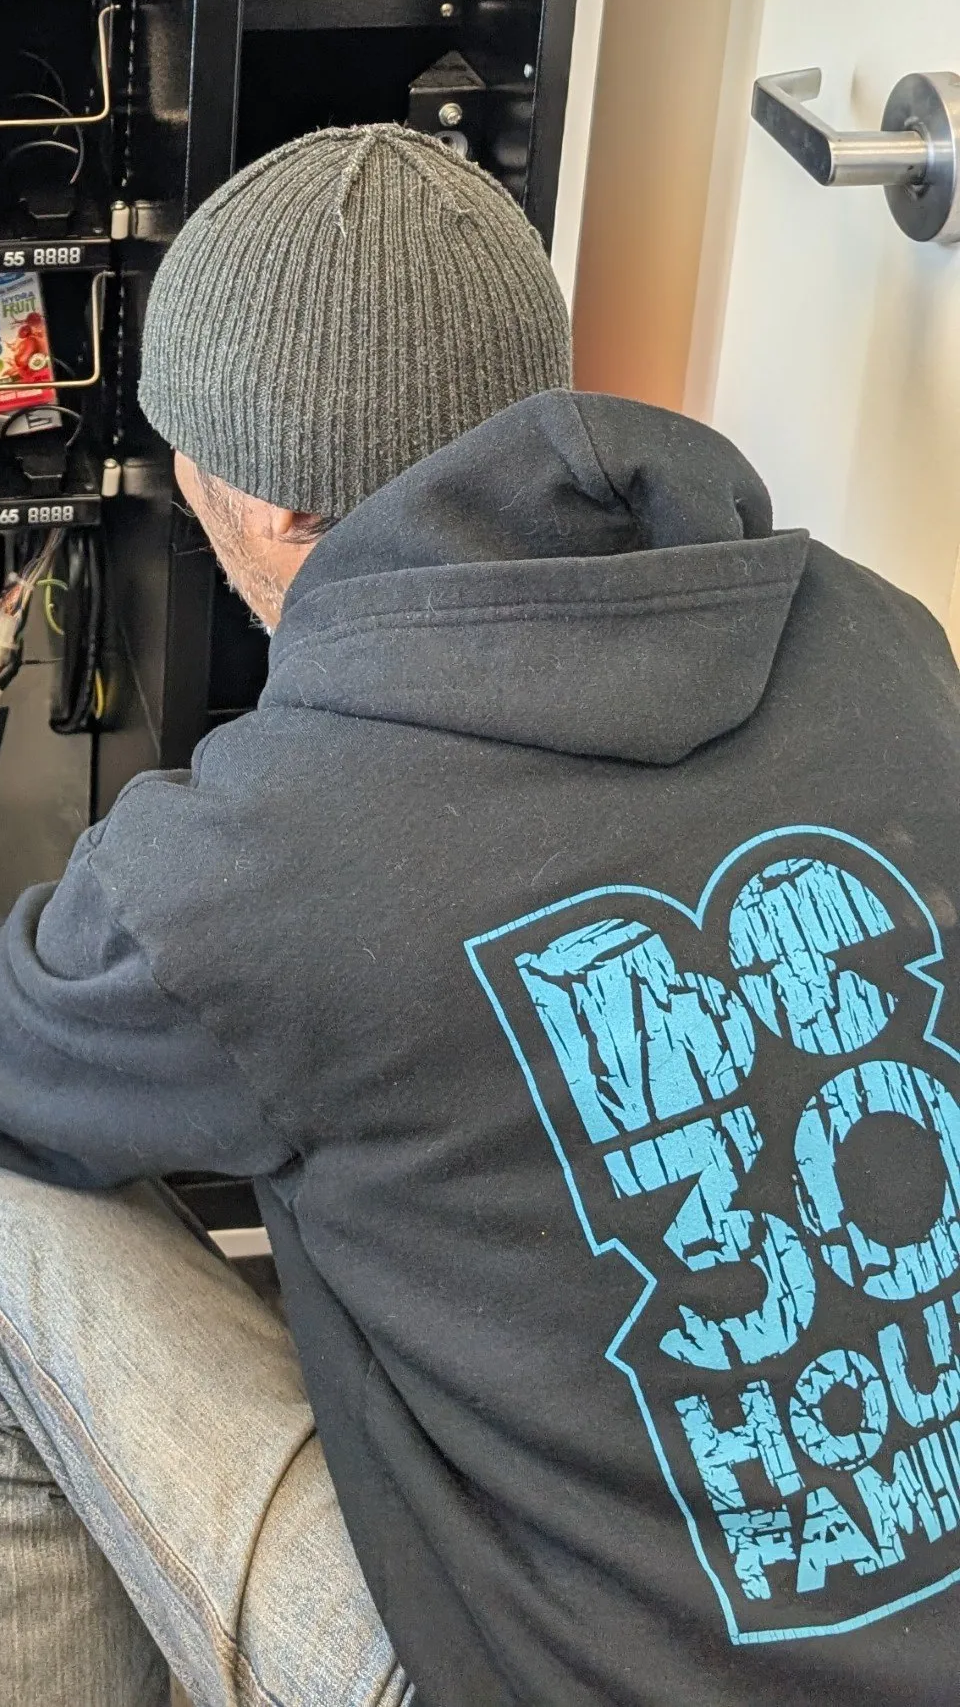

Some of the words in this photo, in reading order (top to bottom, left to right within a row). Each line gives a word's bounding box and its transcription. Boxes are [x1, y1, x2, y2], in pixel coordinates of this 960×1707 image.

[2, 297, 36, 318] FRUIT
[3, 251, 25, 268] 55
[602, 1059, 960, 1371] 30
[674, 1296, 960, 1511] HOU
[717, 1416, 960, 1600] FAMI
